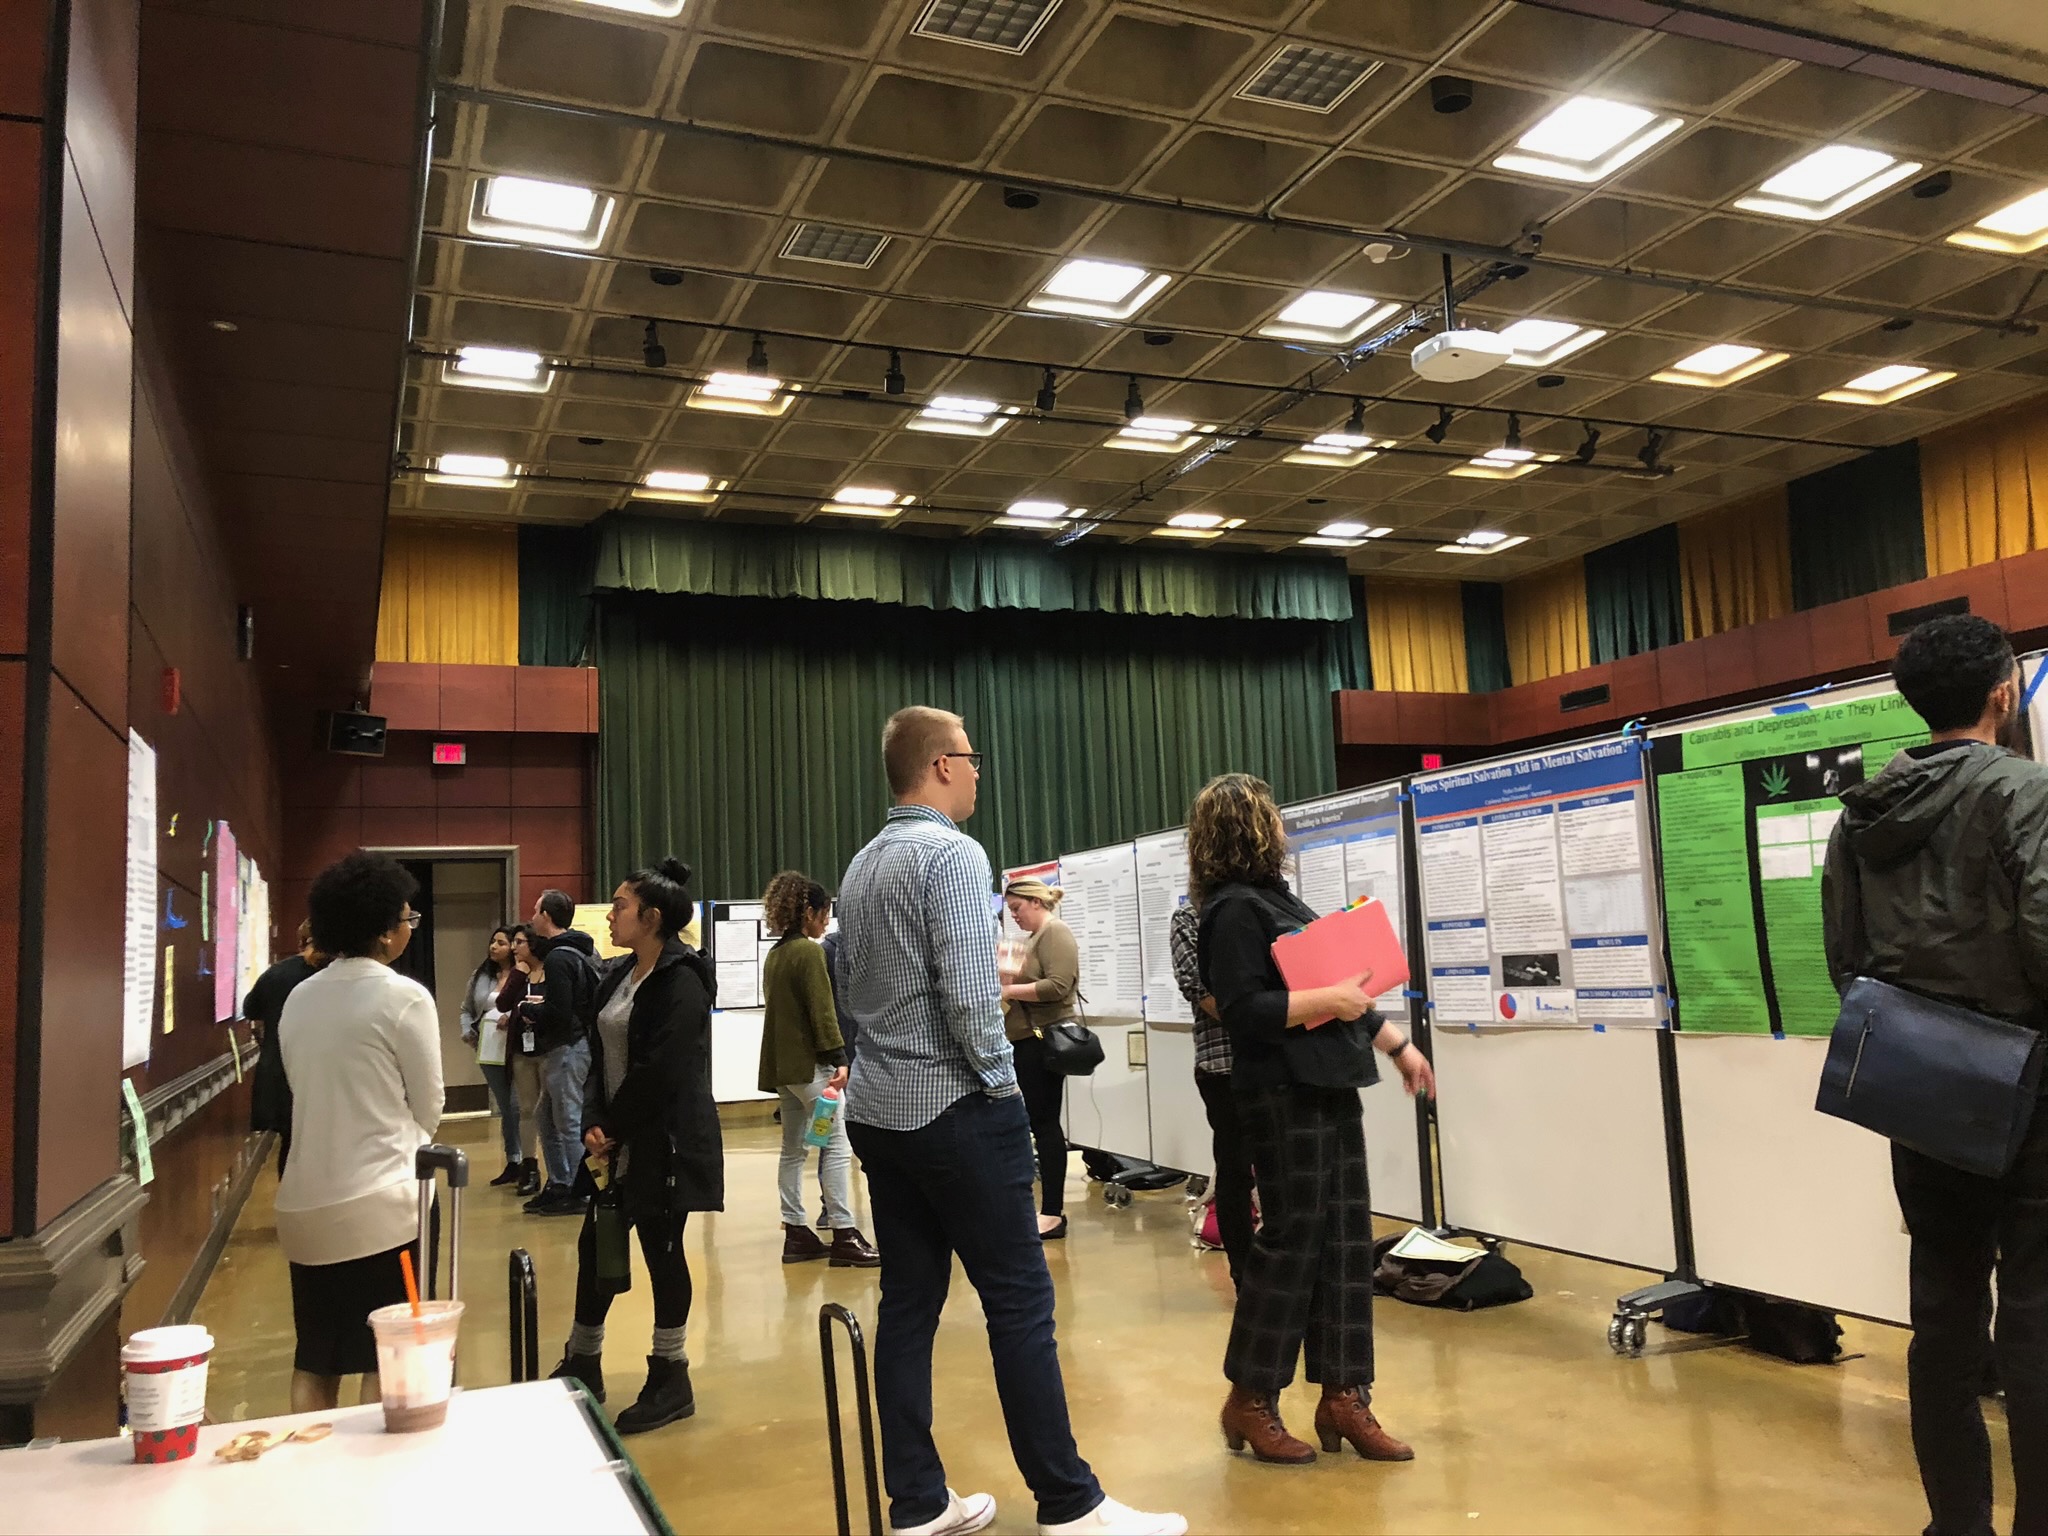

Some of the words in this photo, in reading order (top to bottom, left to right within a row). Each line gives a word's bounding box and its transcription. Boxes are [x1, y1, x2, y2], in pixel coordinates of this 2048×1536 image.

[1689, 728, 1731, 745] Cannabis
[1734, 723, 1754, 736] and
[1757, 712, 1820, 734] Depression:
[1824, 708, 1844, 721] Are
[1847, 701, 1876, 717] They
[1439, 776, 1473, 792] Spiritual
[1474, 767, 1512, 783] Salvation
[1514, 763, 1530, 775] Aid
[1531, 760, 1541, 771] in
[1542, 752, 1575, 769] Mental
